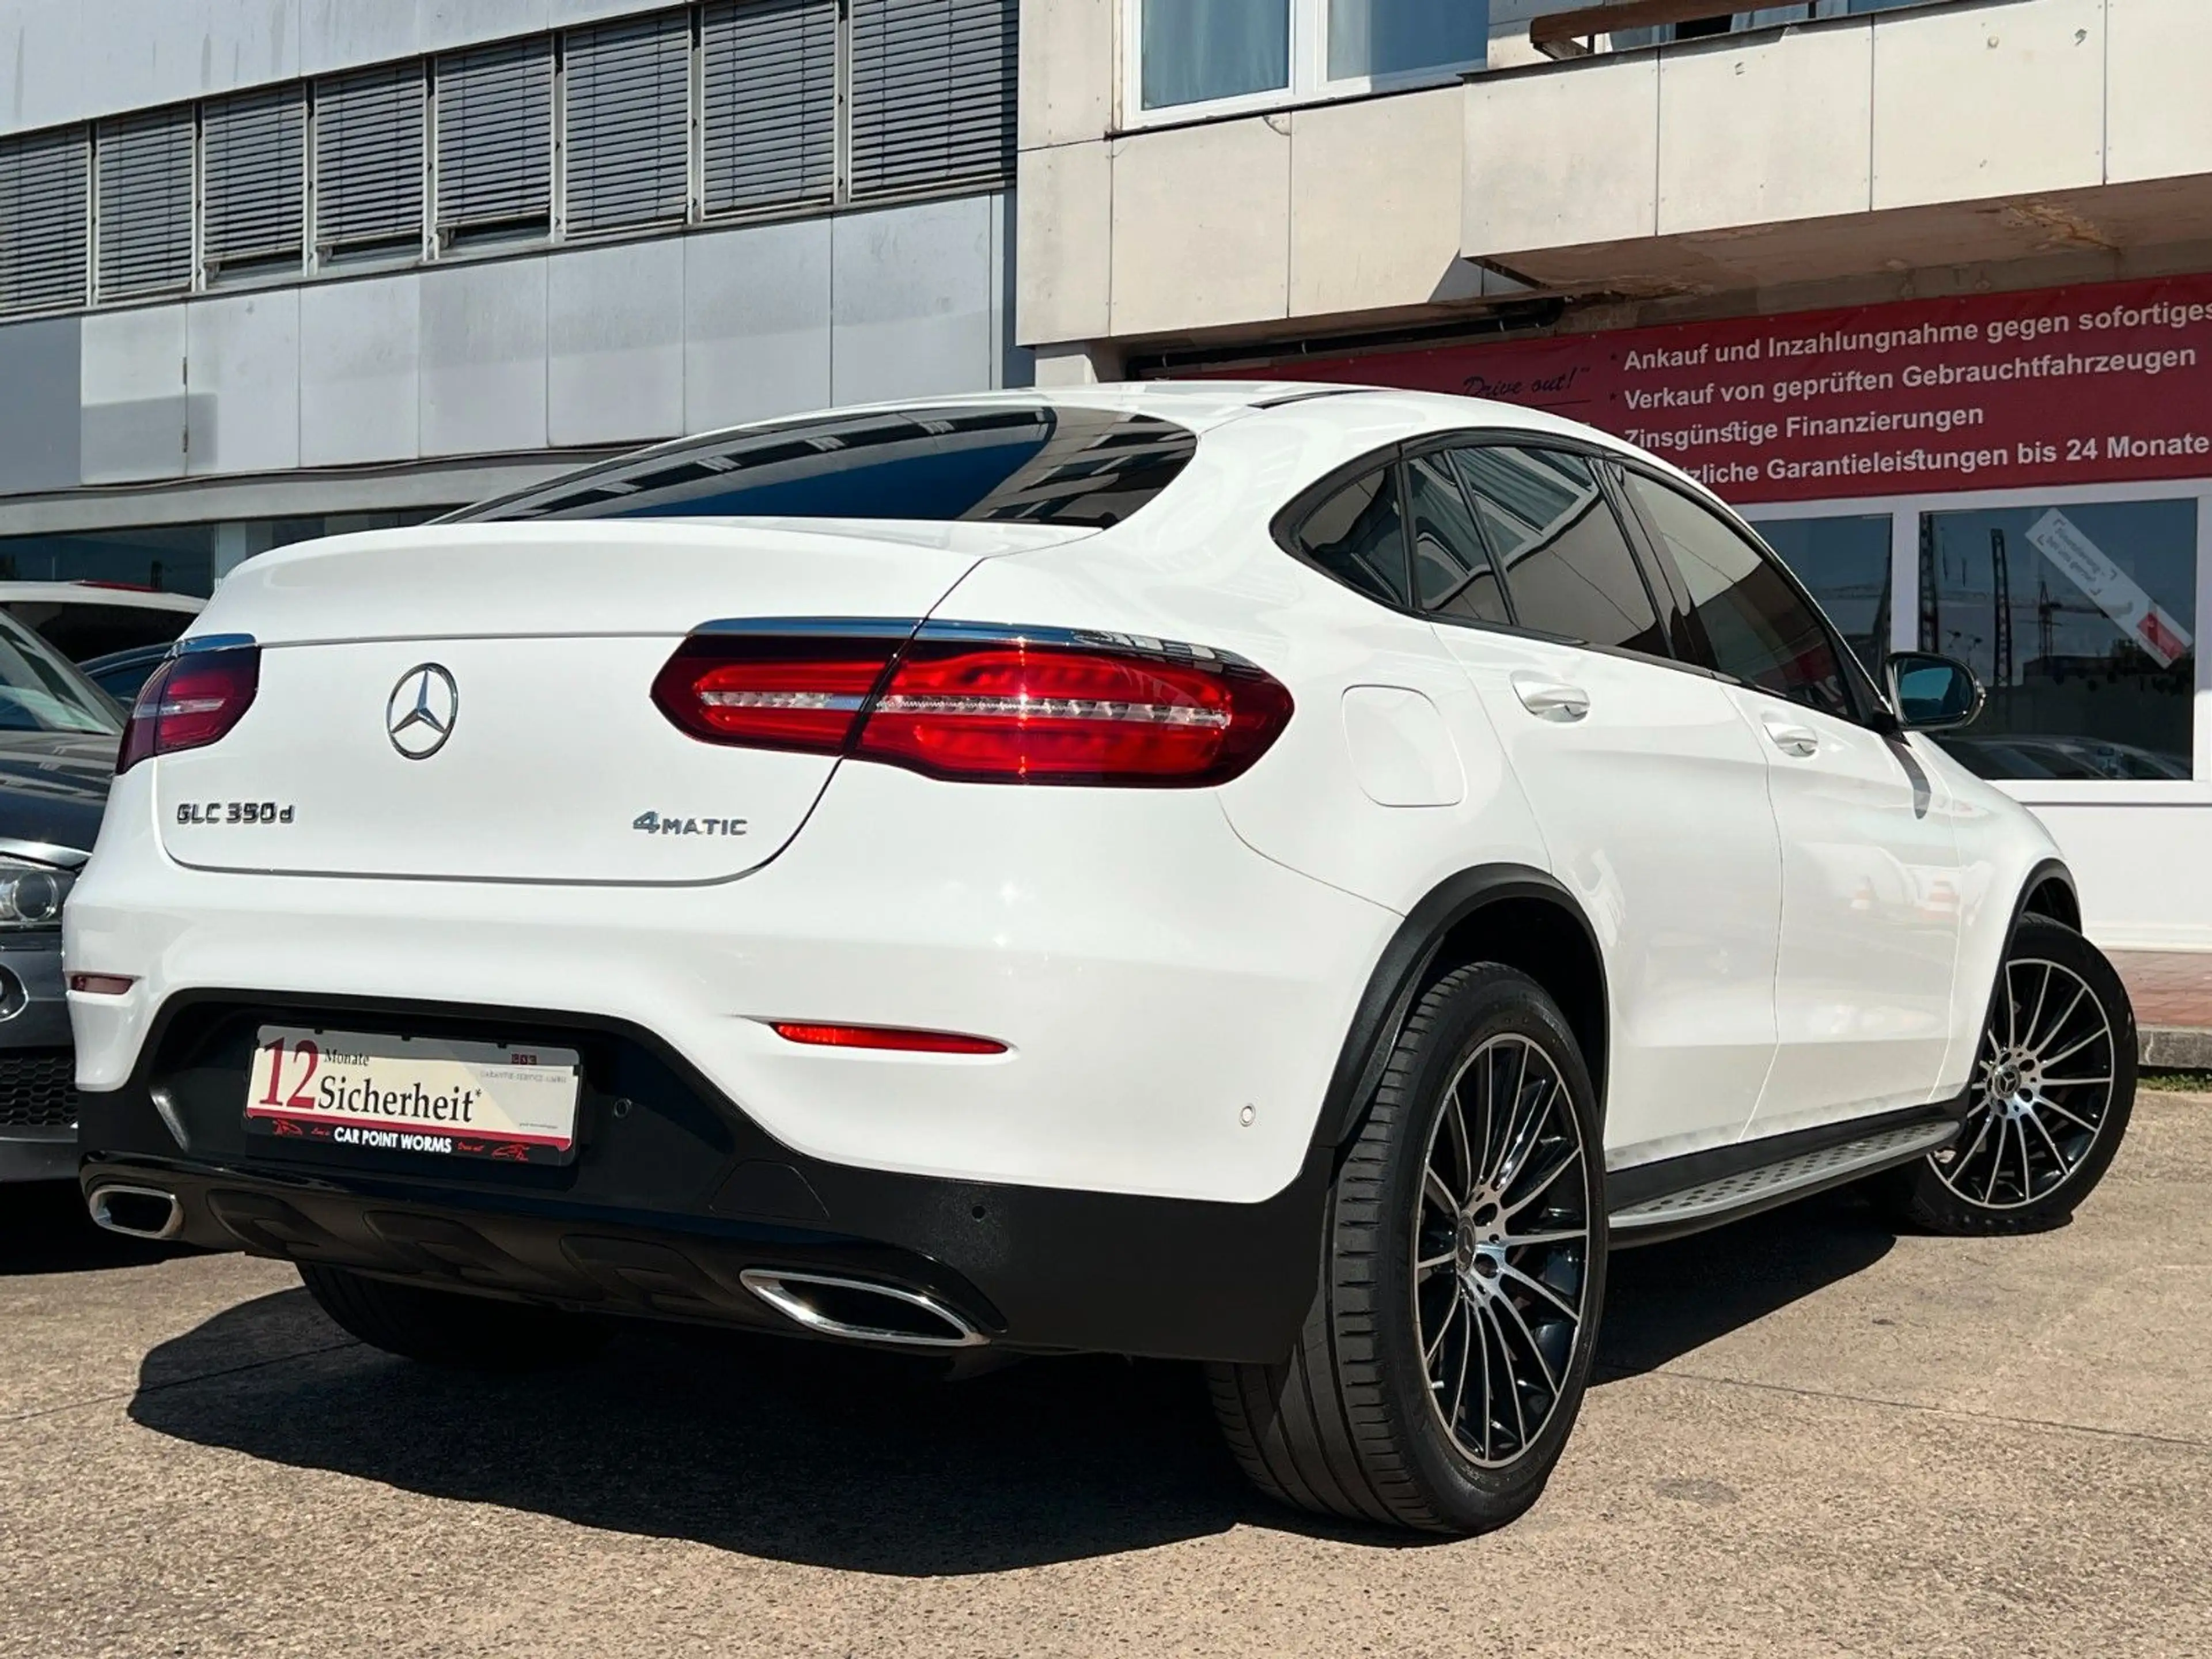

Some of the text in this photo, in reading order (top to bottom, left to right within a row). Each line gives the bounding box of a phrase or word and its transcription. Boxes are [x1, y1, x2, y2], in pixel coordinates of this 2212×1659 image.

[1624, 343, 1709, 371] Ankauf
[1715, 339, 1760, 362] und
[1769, 323, 1978, 358] Inzahlungnahme
[1987, 315, 2069, 343] gegen
[1624, 349, 2195, 410] Verkauf von geprüften Gebrauchtfahrzeugen
[1625, 407, 1983, 450] Zinsgünstige Finanzierungen
[1767, 449, 2008, 479] Garantieleistungen
[2018, 442, 2057, 464] bis
[2066, 438, 2098, 461] 24
[2108, 433, 2210, 459] Monate
[177, 802, 221, 824] GLC
[632, 811, 748, 835] 4MATIC
[259, 1037, 319, 1110] 12
[324, 1048, 370, 1067] Monate
[334, 1127, 359, 1145] CAR
[362, 1130, 397, 1149] POINT
[401, 1134, 452, 1153] WORMS
